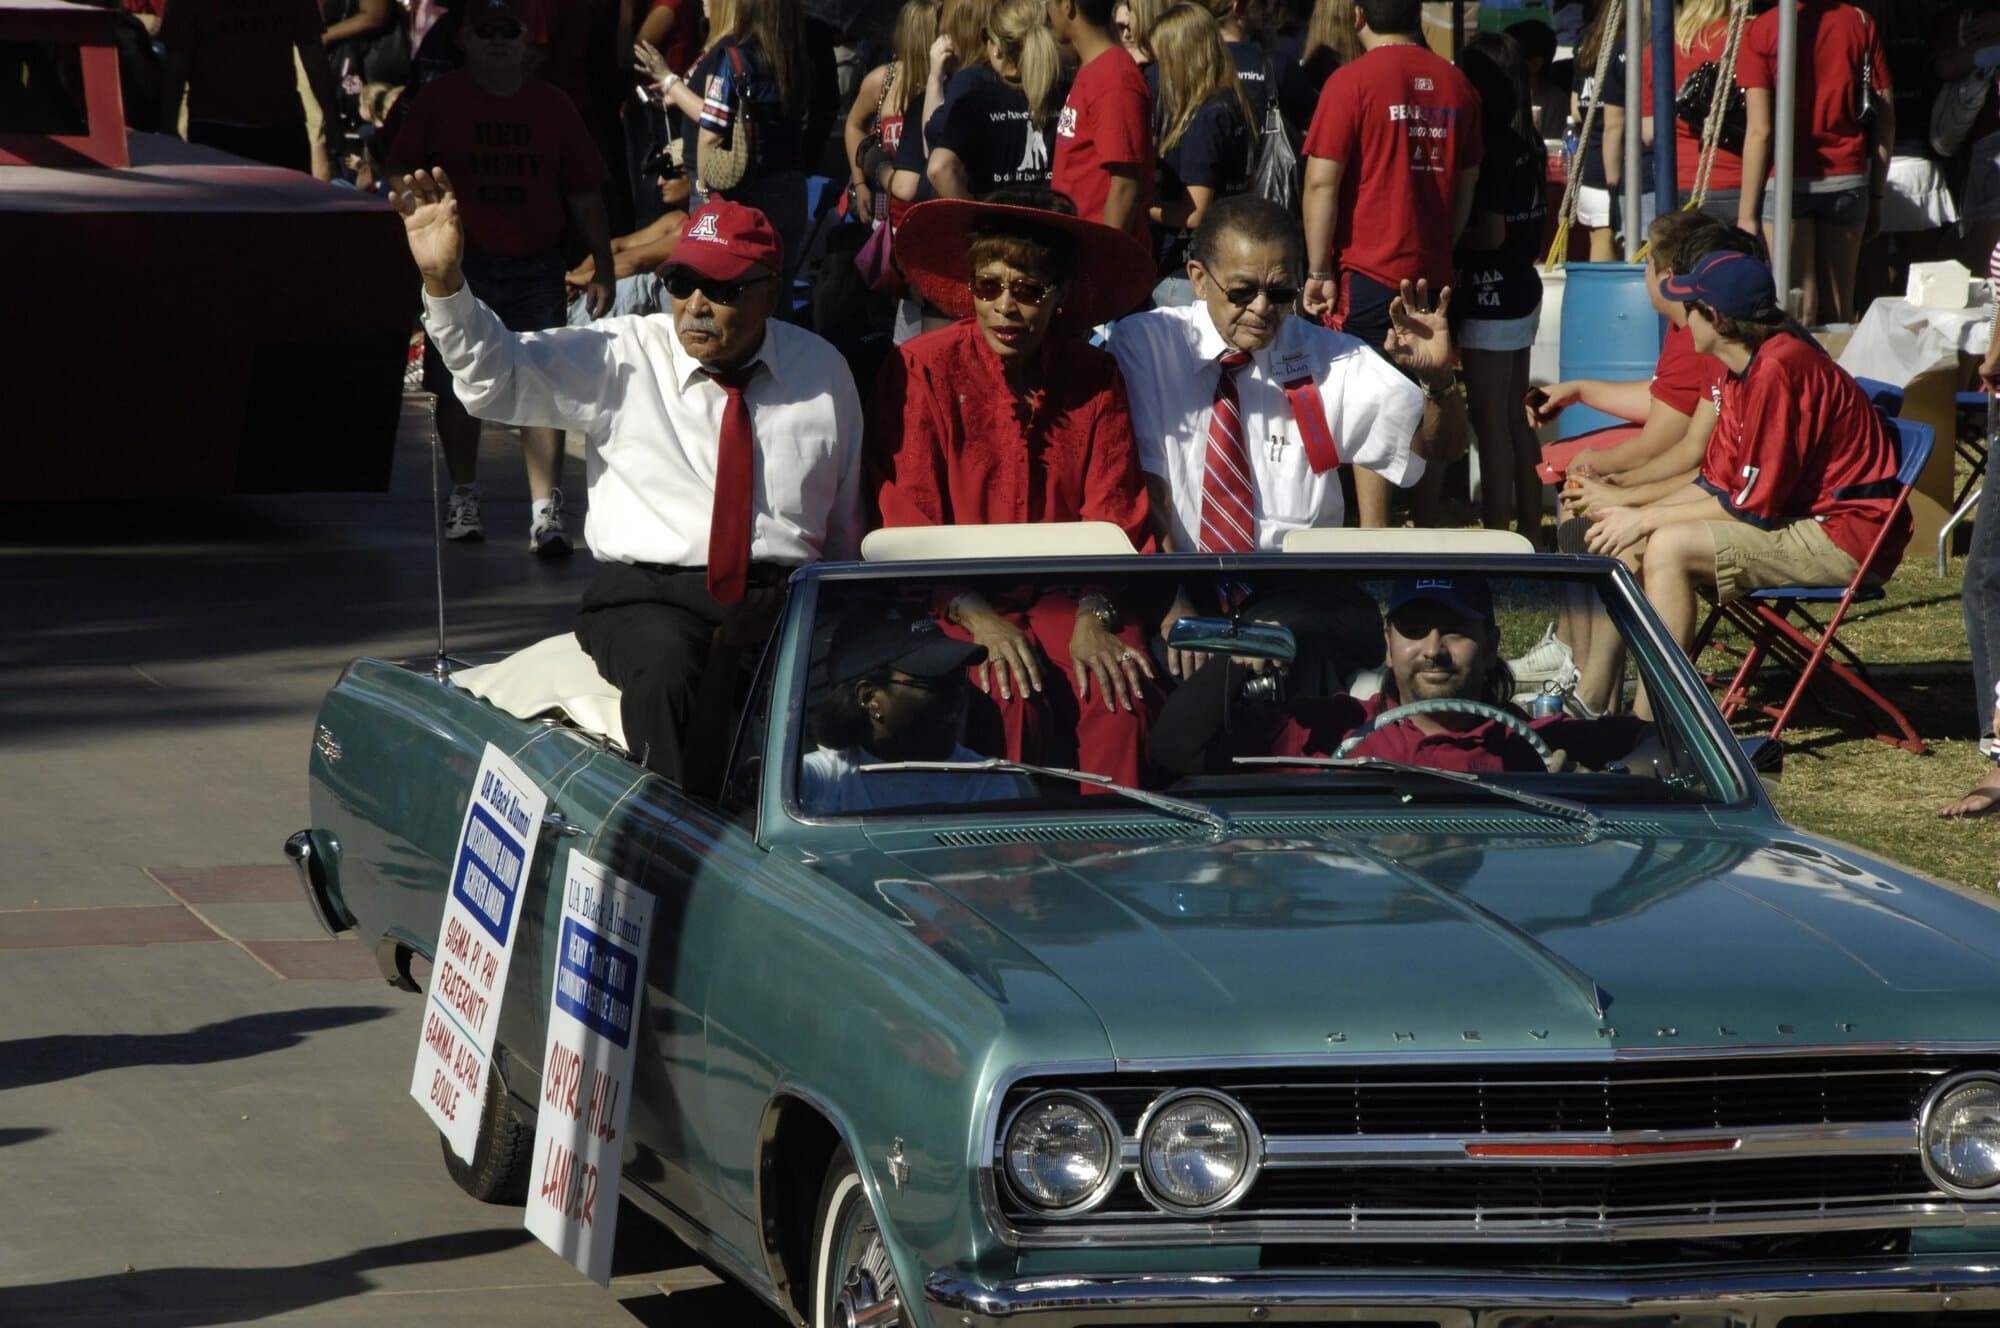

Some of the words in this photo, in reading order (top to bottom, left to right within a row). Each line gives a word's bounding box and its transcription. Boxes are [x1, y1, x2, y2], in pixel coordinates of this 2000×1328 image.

[475, 122, 530, 146] RED
[989, 112, 1006, 122] We
[1007, 110, 1029, 120] have
[466, 153, 545, 177] ARMY
[688, 213, 719, 238] A
[1736, 465, 1760, 506] 7
[481, 769, 495, 801] UA
[491, 779, 512, 817] Black
[507, 795, 533, 839] Alumni
[568, 878, 582, 913] UA
[582, 886, 605, 928] Black
[606, 902, 644, 948] Alumni
[445, 916, 472, 964] SIGMA
[471, 940, 483, 971] PI
[480, 952, 499, 992] PHI
[567, 931, 589, 969] HENRY
[438, 961, 489, 1034] FRATERNITY
[425, 1012, 456, 1068] GAMMA
[453, 1044, 482, 1097] ALPHA
[1326, 1023, 1855, 1042] CHEVROLET
[430, 1068, 461, 1121] BOULE
[546, 1040, 586, 1121] CHYRL
[586, 1069, 620, 1144] HILL
[541, 1136, 598, 1229] LANDER
